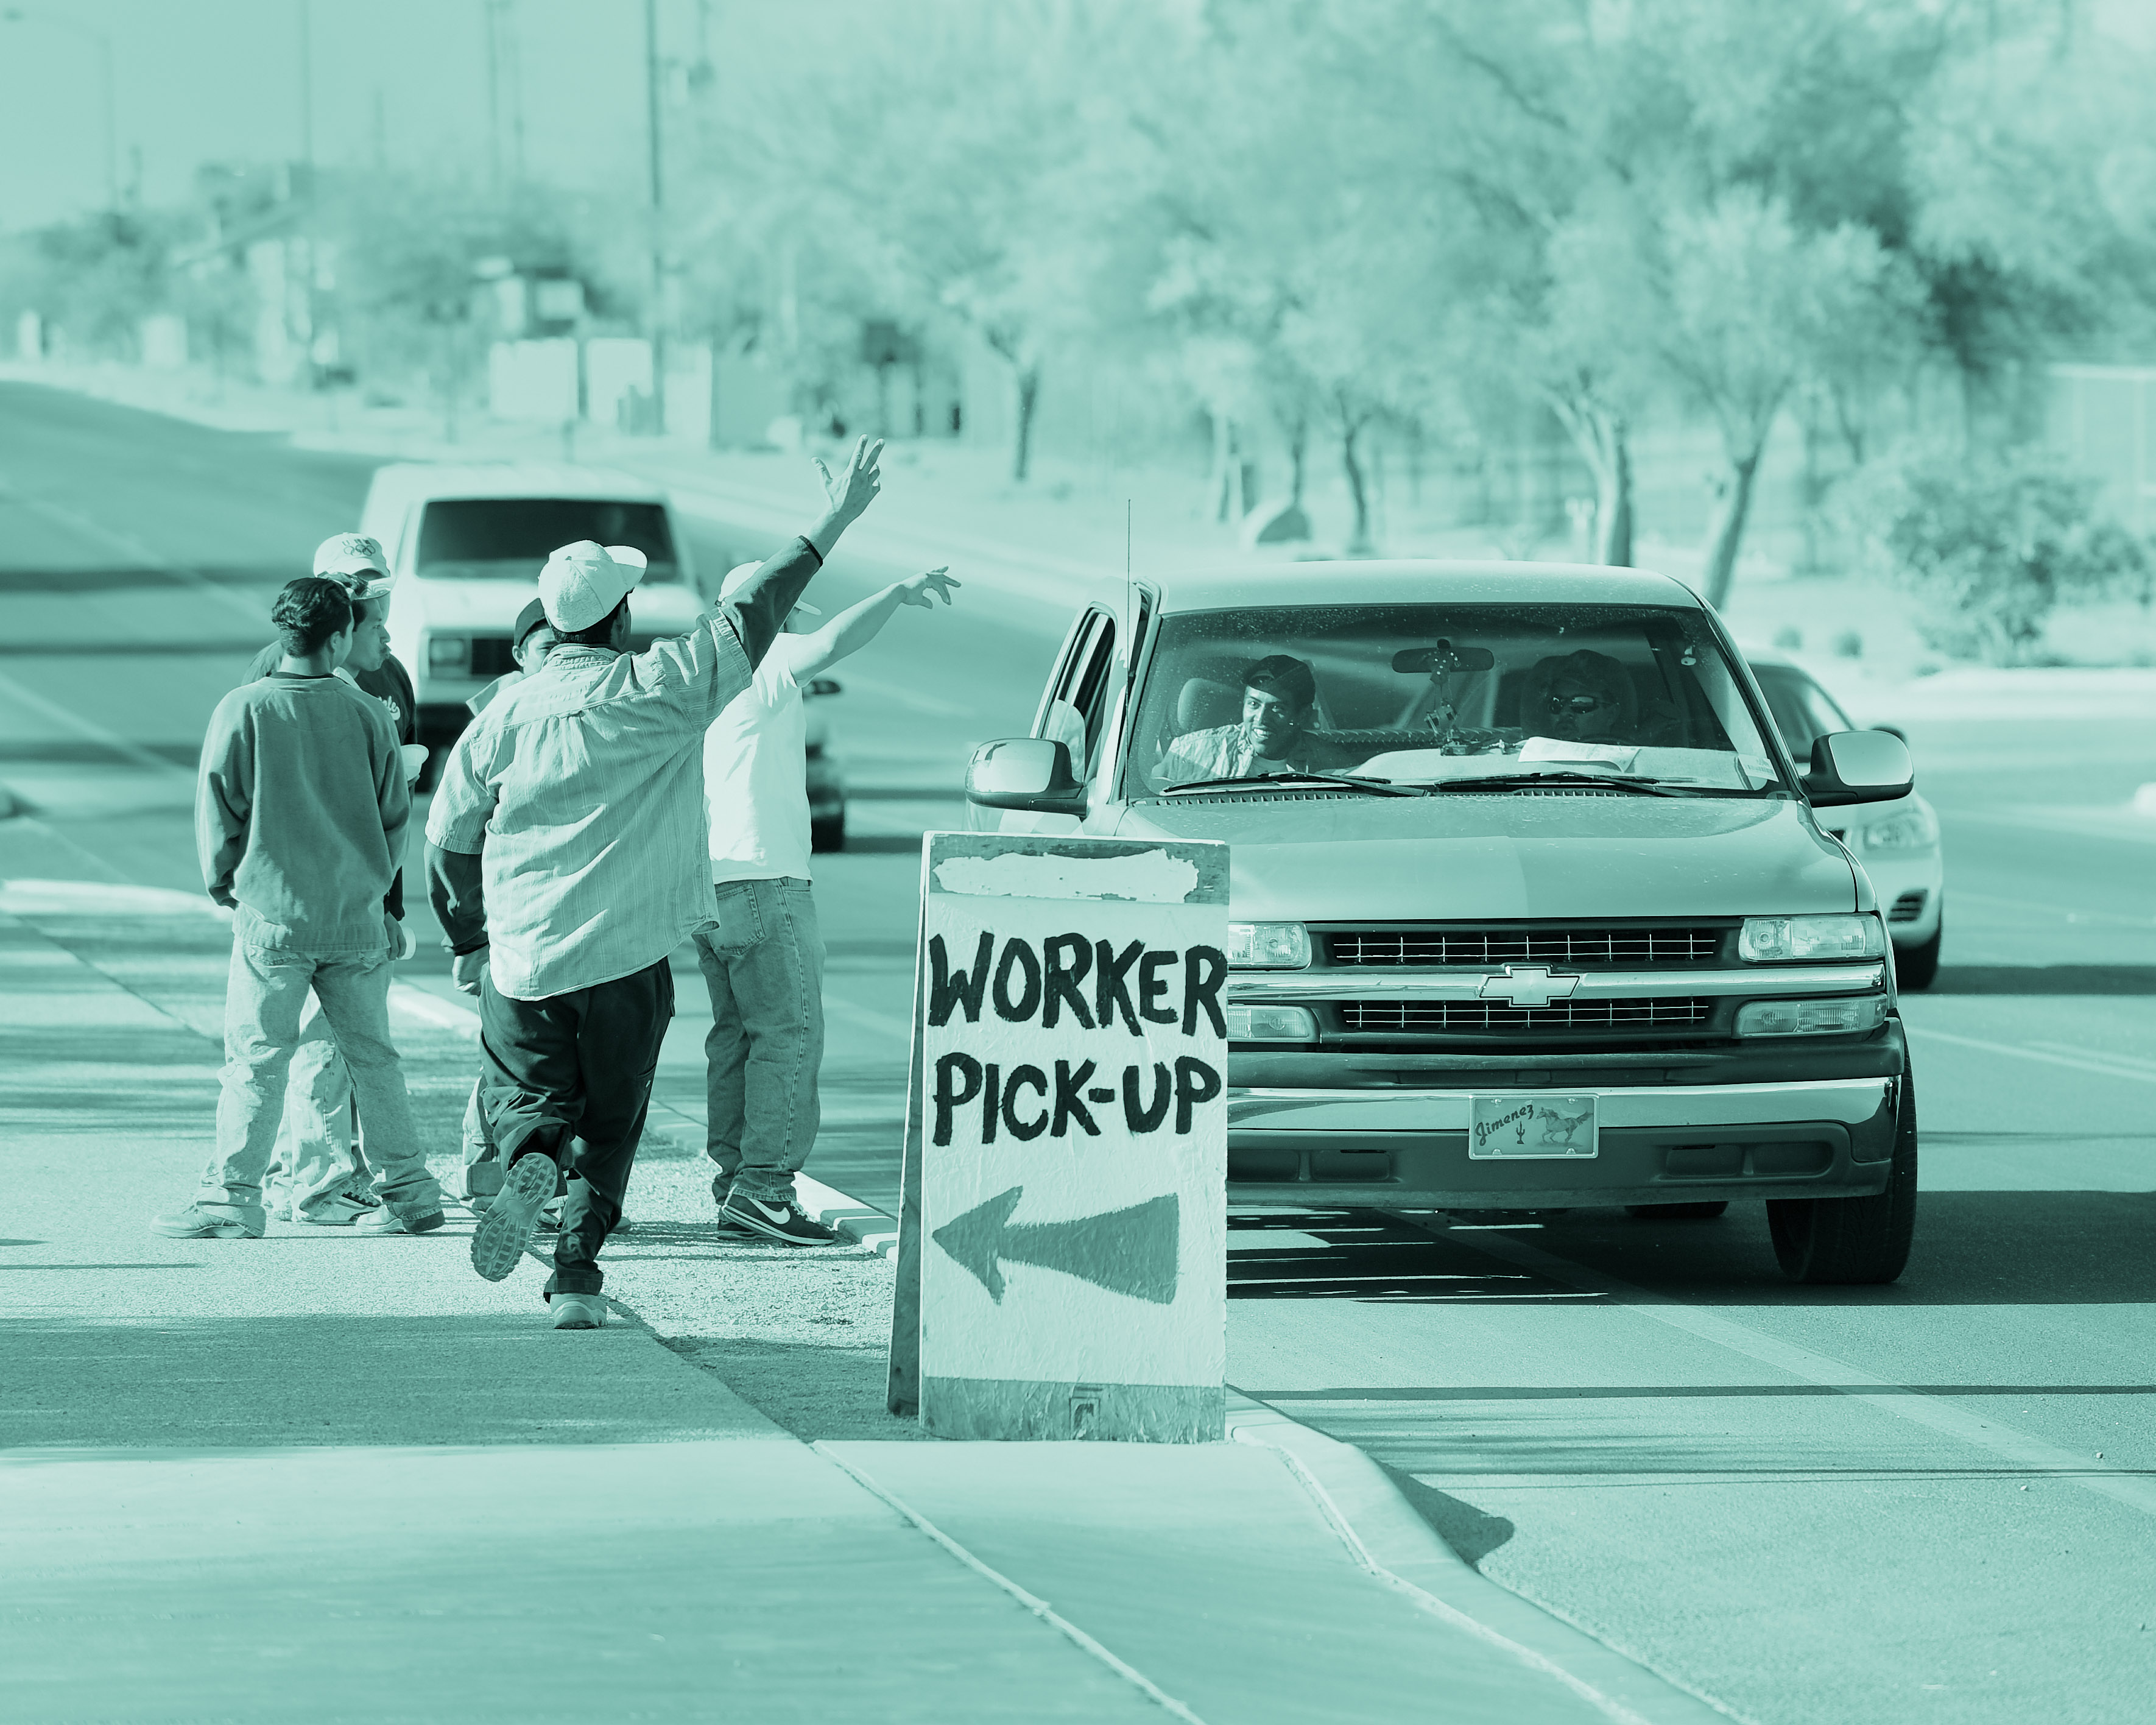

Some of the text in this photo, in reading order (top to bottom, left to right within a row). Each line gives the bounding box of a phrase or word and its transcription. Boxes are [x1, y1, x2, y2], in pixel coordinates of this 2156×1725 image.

[928, 930, 1228, 1039] WORKER
[932, 1052, 1222, 1146] PICK-UP
[1474, 1104, 1534, 1146] Jimenez
